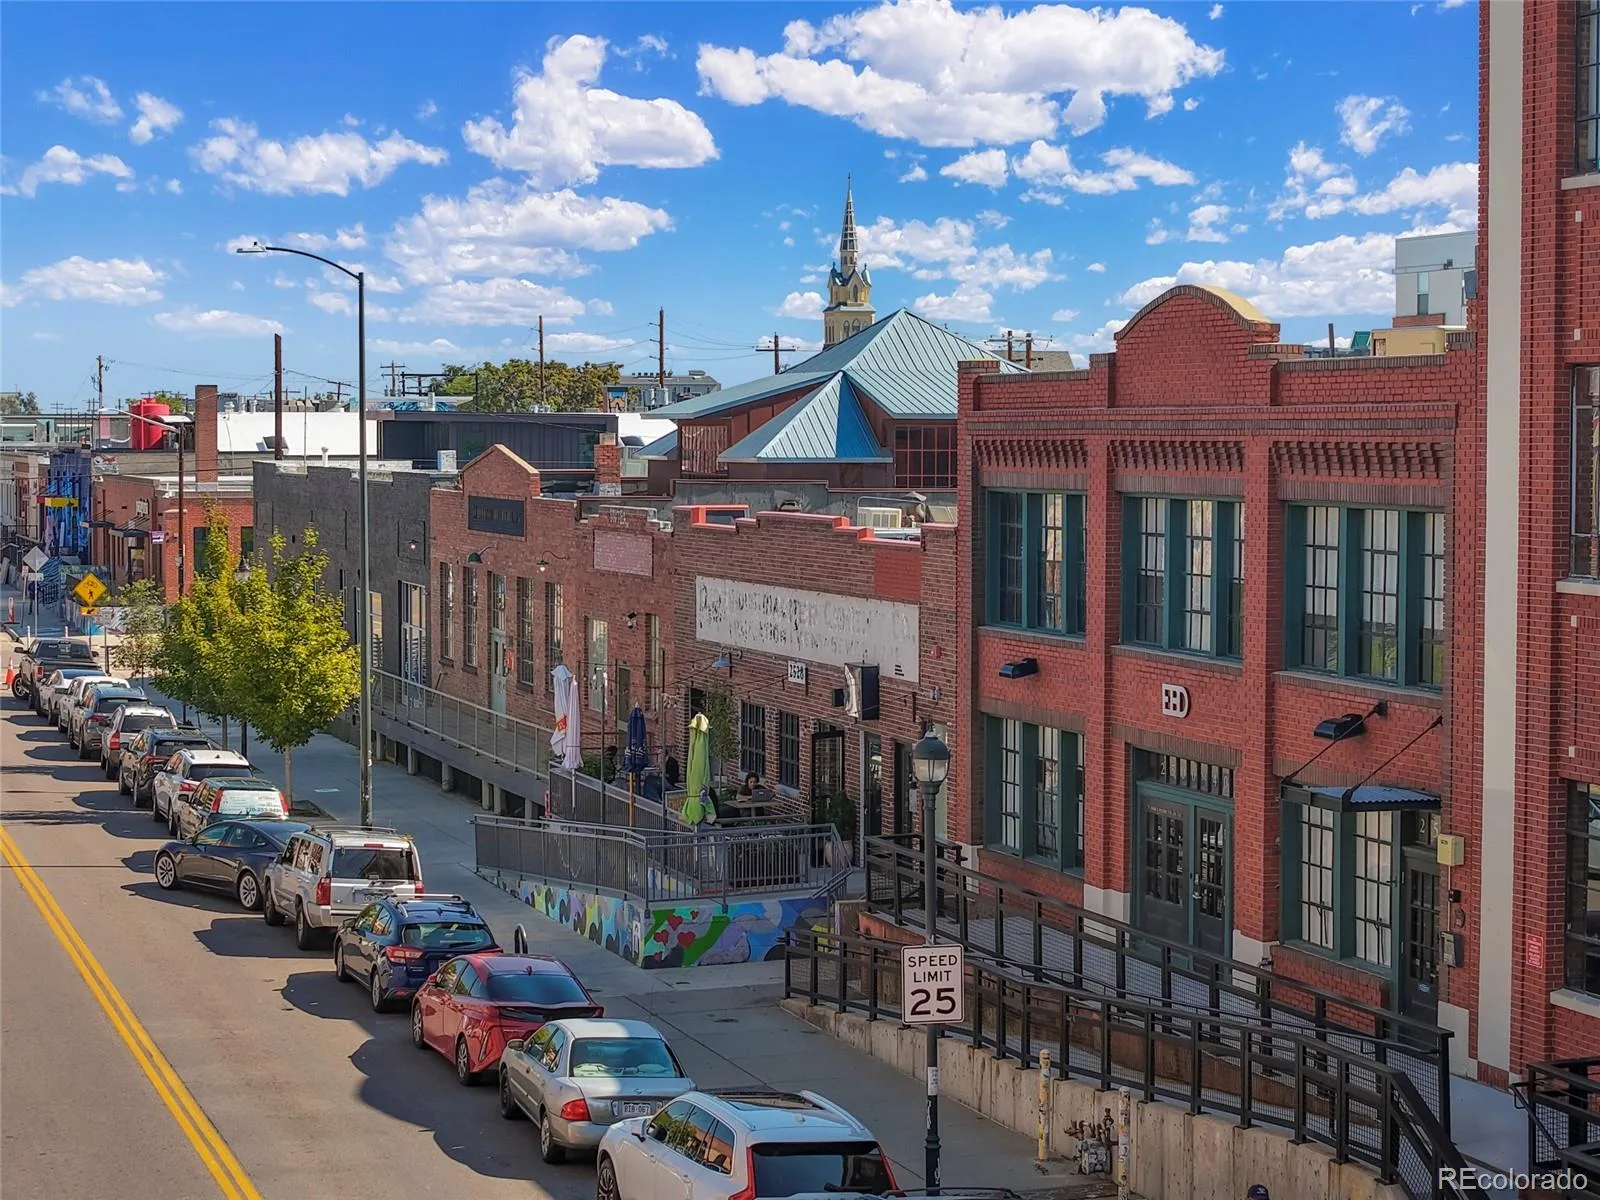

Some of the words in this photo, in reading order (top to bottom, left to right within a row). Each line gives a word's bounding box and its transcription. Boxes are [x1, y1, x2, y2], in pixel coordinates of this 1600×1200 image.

[908, 954, 958, 968] SPEED
[913, 970, 952, 983] LIMIT
[910, 987, 956, 1016] 25
